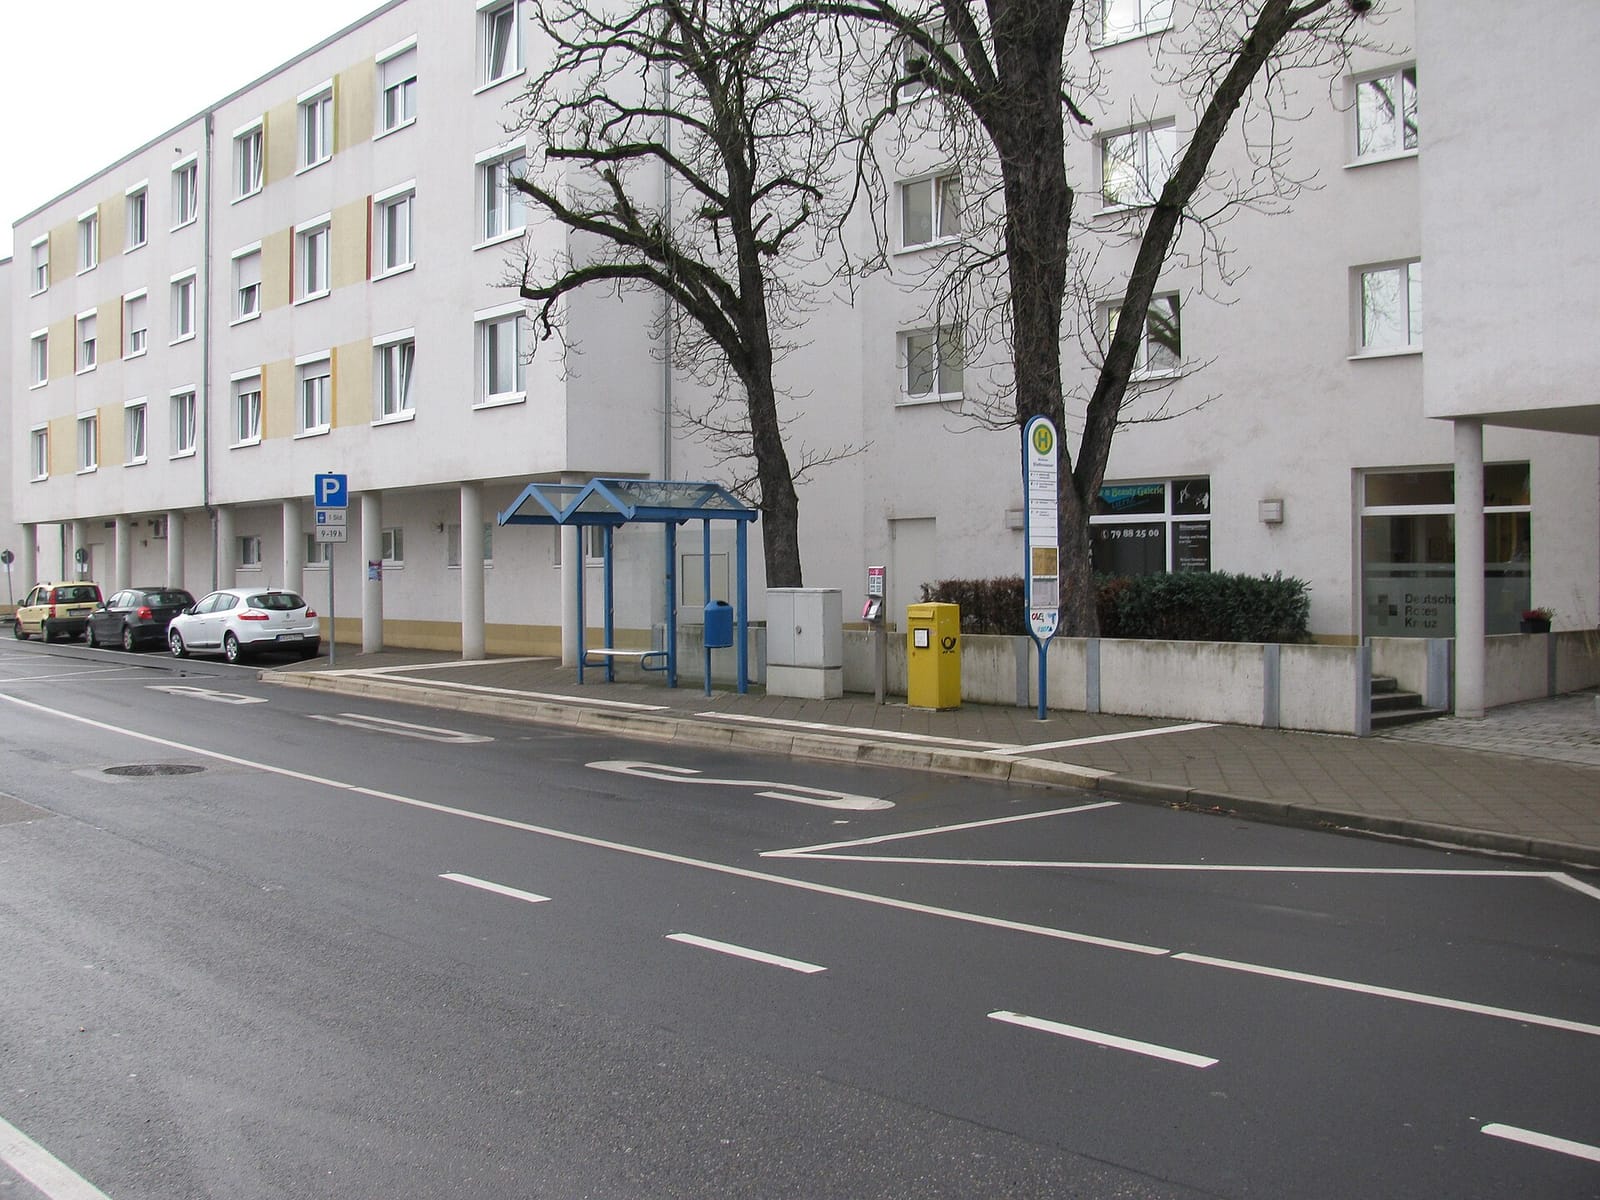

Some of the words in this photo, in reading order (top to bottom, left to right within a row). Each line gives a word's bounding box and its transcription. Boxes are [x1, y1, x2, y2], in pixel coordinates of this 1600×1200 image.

[1038, 431, 1049, 449] H
[322, 478, 340, 503] P
[1111, 487, 1137, 498] Beauty
[1137, 486, 1164, 497] Galerie
[1111, 530, 1121, 539] 79
[1123, 529, 1133, 537] 88
[1135, 529, 1146, 538] 25
[1148, 529, 1159, 537] 00
[1405, 593, 1455, 604] Detsche
[1405, 617, 1437, 628] Kruz
[145, 685, 896, 811] BUS
